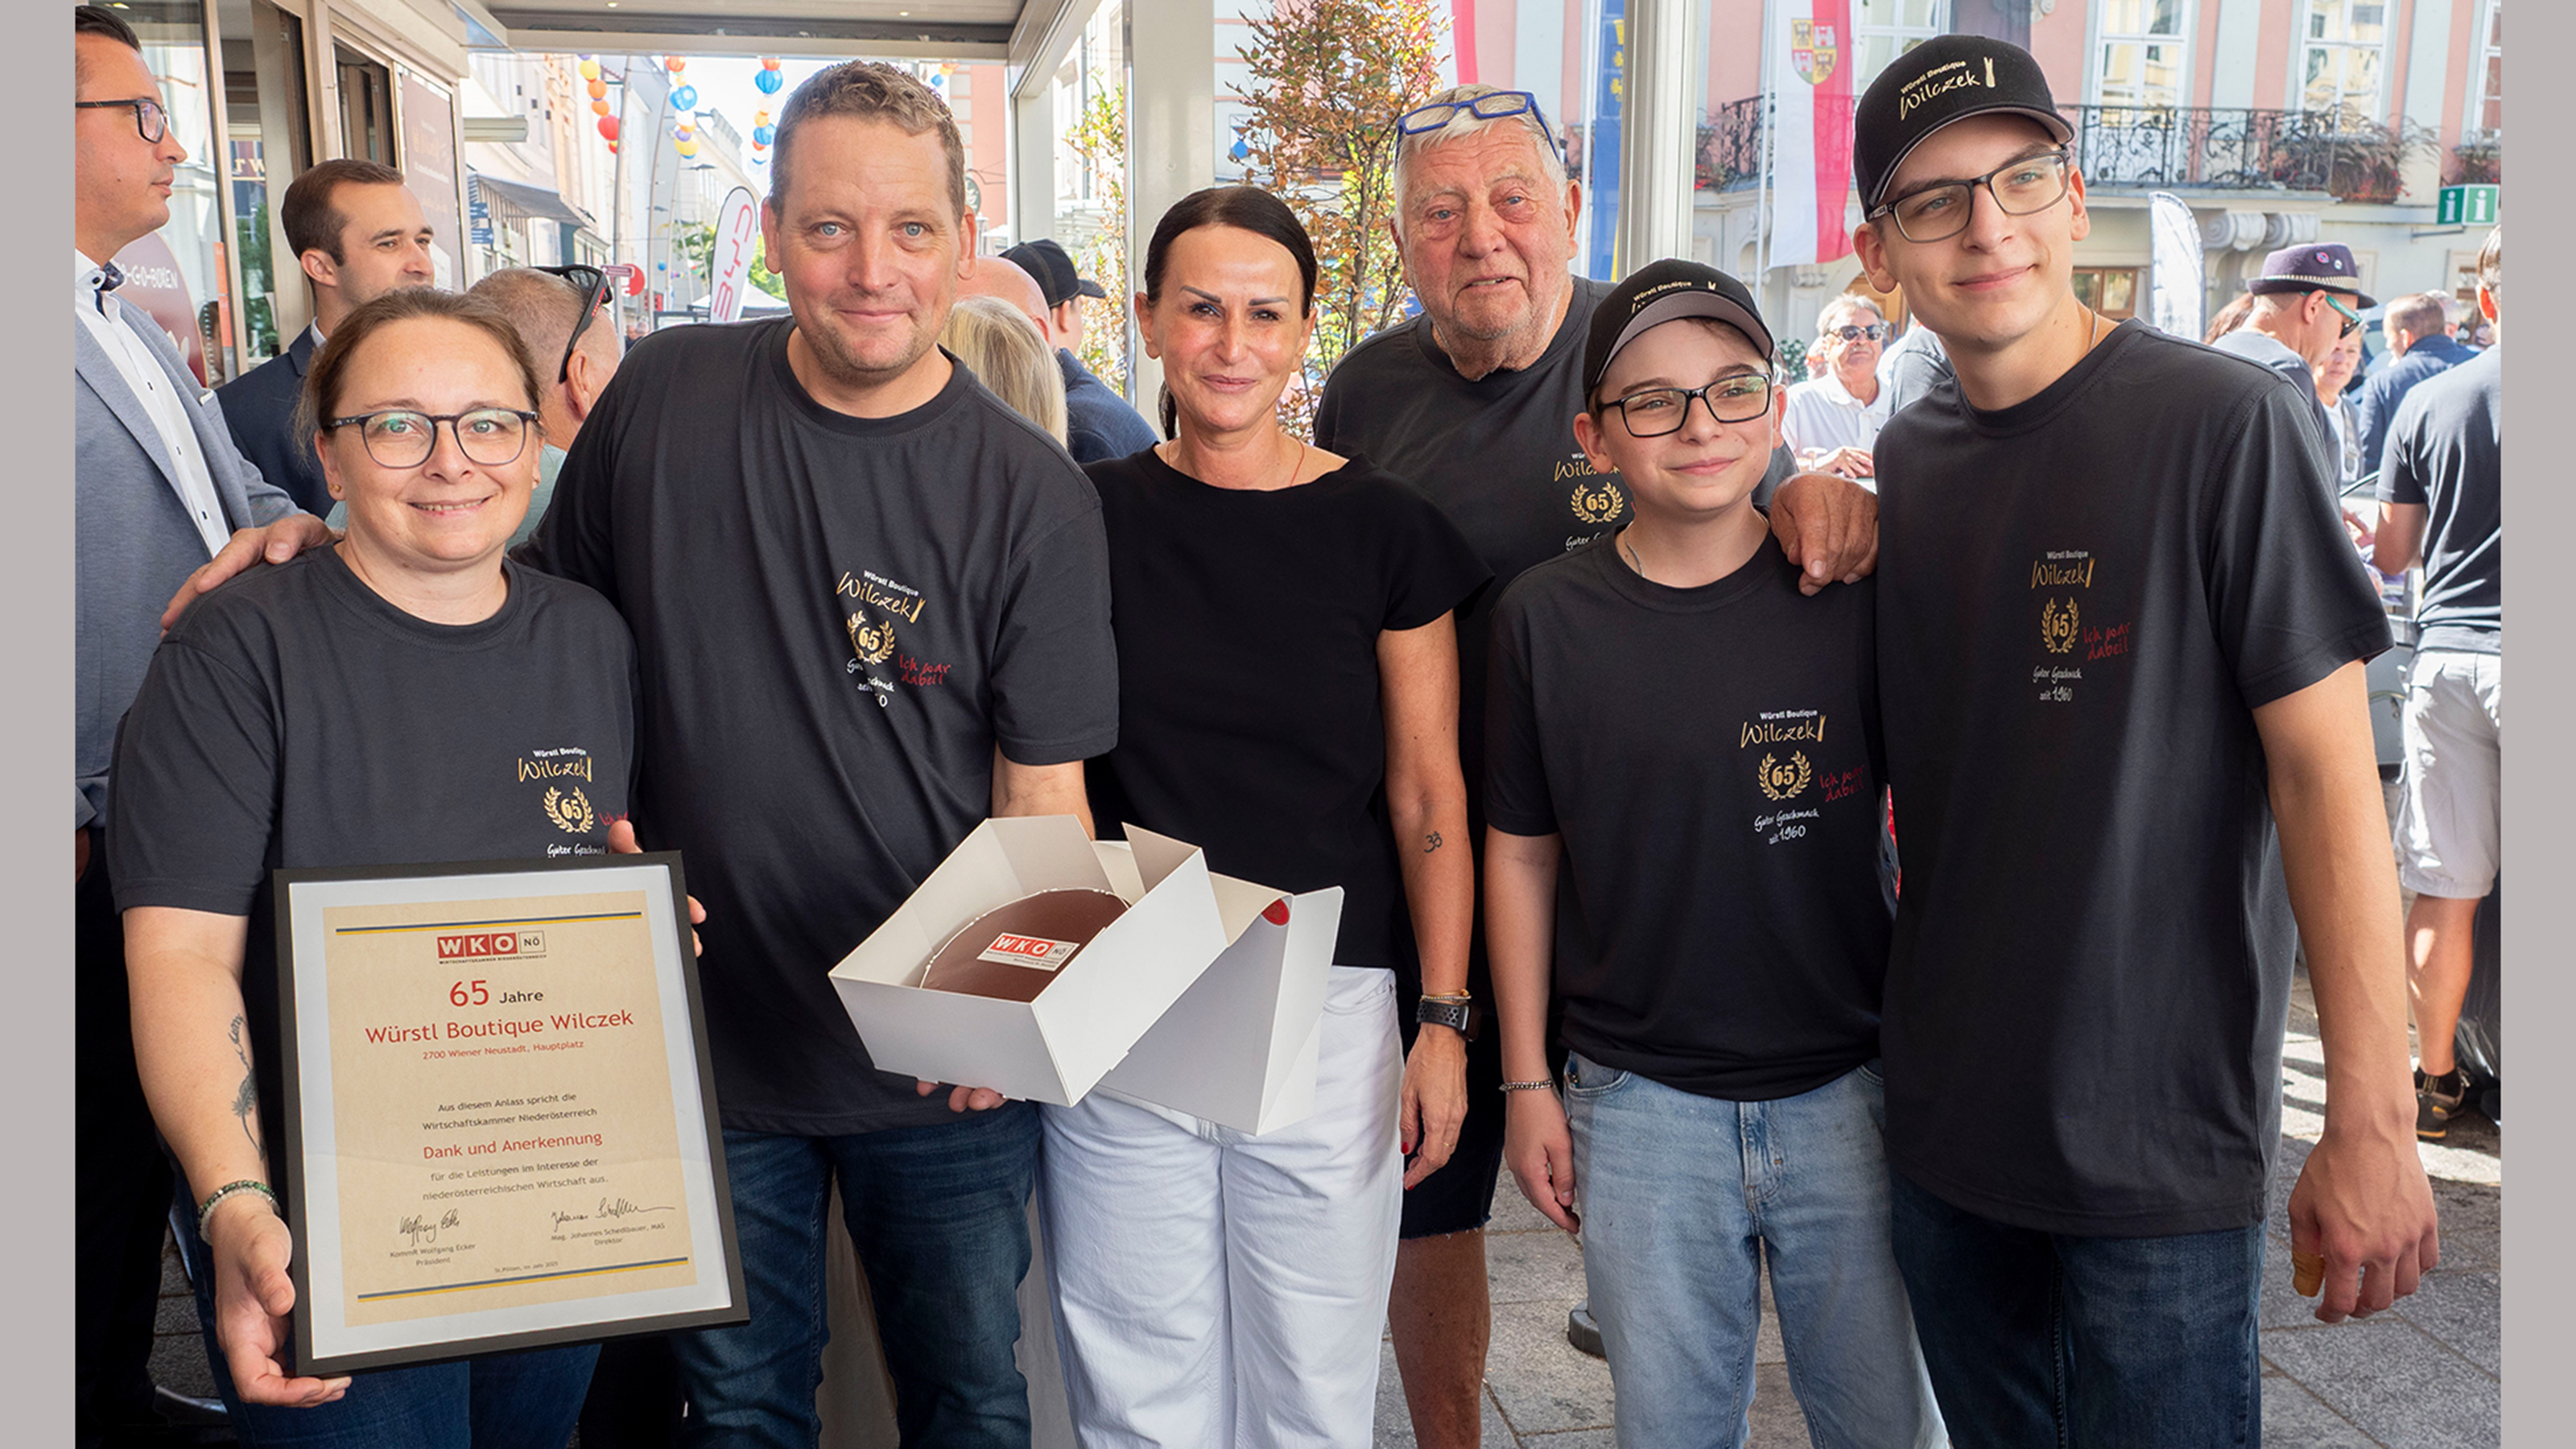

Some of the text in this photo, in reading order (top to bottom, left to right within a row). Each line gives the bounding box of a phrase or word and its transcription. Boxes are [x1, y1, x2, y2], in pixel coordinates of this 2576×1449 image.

[1901, 69, 1980, 121] Wilczek
[1586, 493, 1609, 511] 65
[2031, 559, 2086, 589] Wilczek
[836, 571, 910, 618] Wilczek
[2053, 613, 2070, 638] 65
[858, 626, 881, 651] 65
[899, 654, 918, 671] Ich
[1760, 708, 1818, 720] Würstl Boutique
[1740, 720, 1817, 749] Wilczek
[518, 757, 588, 782] Wilczek
[1771, 764, 1795, 786] 65
[560, 798, 583, 819] 65
[1779, 824, 1806, 840] 1960
[440, 935, 540, 956] WKO NÖ
[996, 937, 1049, 955] WKO
[449, 980, 543, 1007] 65 Jahre
[365, 1009, 634, 1044] Würstl Boutique Wilczek
[423, 1041, 584, 1060] 2700 Wiener Neustadt, Hauptplatz
[438, 1093, 577, 1113] Aus diesem Anlass spricht die
[422, 1108, 597, 1130] Wirtschaftskammer Niederösterreich
[423, 1133, 603, 1159] Dank und Anerkennung
[431, 1158, 598, 1182] für die Leistungen im Interesse der
[423, 1176, 609, 1201] niederösterreichischen Wirtschaft aus.
[570, 1229, 602, 1240] Johannes
[650, 1222, 666, 1230] MAS
[593, 1237, 623, 1246] Direktor
[390, 1243, 477, 1257] KommR Wolfgang Ecker
[415, 1257, 451, 1266] Präsident
